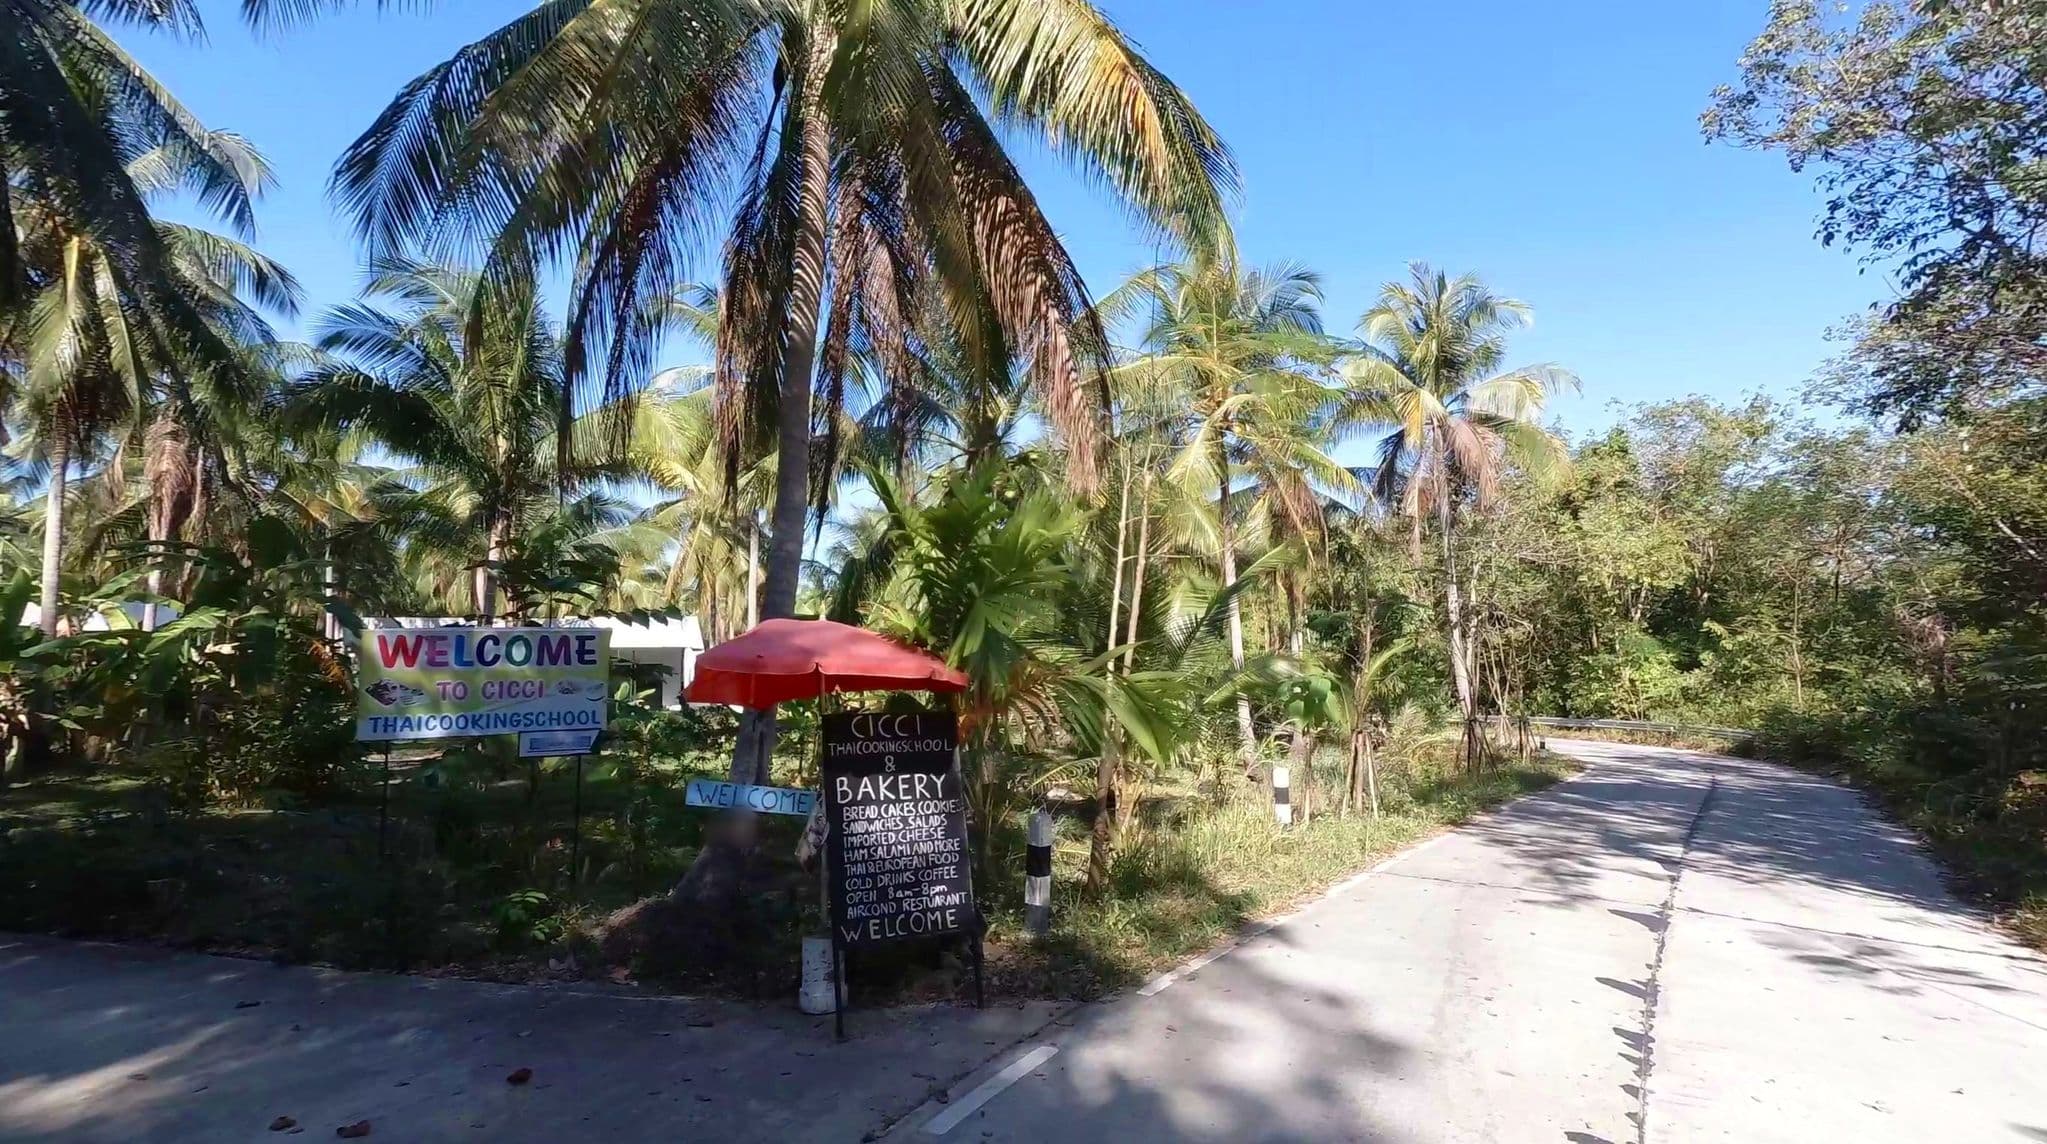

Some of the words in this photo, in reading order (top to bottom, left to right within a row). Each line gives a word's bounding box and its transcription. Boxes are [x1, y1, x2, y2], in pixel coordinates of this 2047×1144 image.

[377, 634, 598, 668] WELCOME
[436, 681, 468, 701] TO
[482, 680, 545, 699] CICCI
[368, 710, 601, 734] THAICOOKINGSCHOOL
[851, 714, 921, 738] CICCI
[829, 738, 952, 756] THAICOOKINGSCHOOL
[884, 755, 896, 772] &
[836, 773, 946, 804] BAKERY
[899, 827, 945, 843] CHEESE
[844, 864, 866, 877] THAI
[929, 853, 960, 866] FOOD
[845, 878, 872, 890] COLD
[877, 870, 915, 887] DRINKS
[918, 866, 959, 881] COFFEE
[847, 903, 897, 919] AIRCOND
[840, 908, 959, 943] WELCOME
